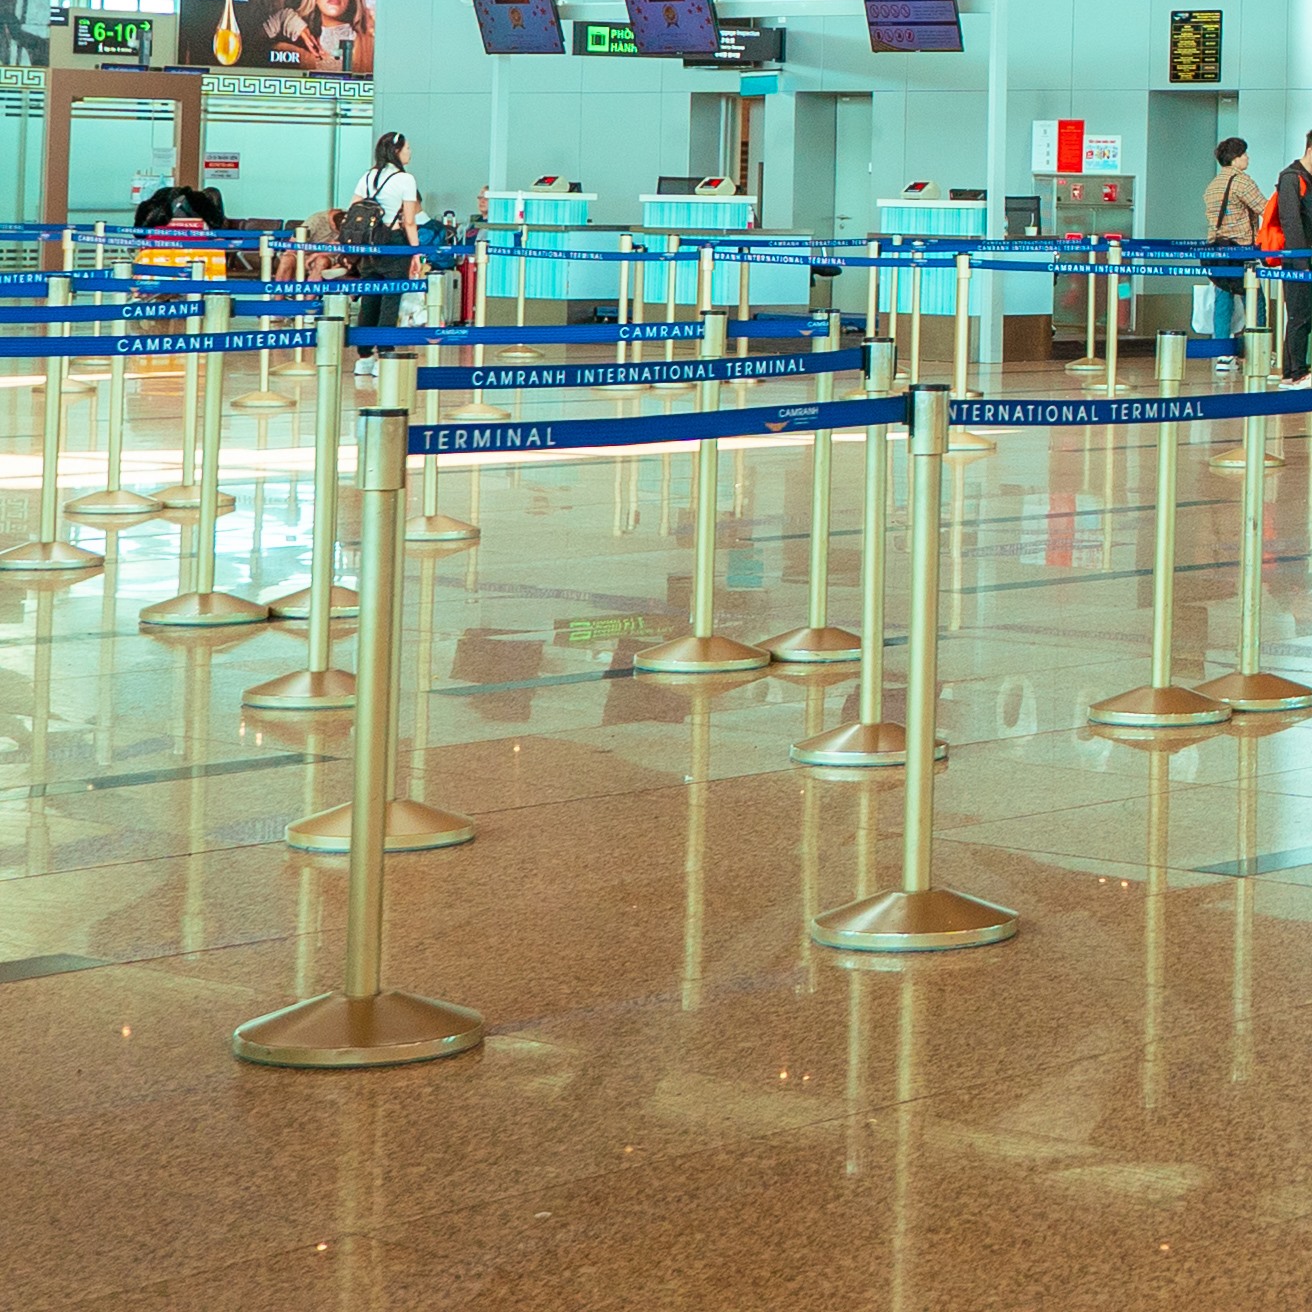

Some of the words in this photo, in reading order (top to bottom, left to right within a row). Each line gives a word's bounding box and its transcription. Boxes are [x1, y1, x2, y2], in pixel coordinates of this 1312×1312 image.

[93, 21, 137, 42] 6-10
[611, 28, 634, 39] PHÒ
[270, 51, 300, 63] DIOR
[78, 235, 106, 243] CAMRANH
[108, 236, 152, 247] INTERNATIONAL
[294, 242, 345, 252] INTERNATIONAL
[348, 245, 381, 253] TERMINAL
[513, 248, 566, 258] INTERNATIONAL
[570, 252, 603, 260] TERMINAL
[744, 253, 803, 264] INTERNATIONAL
[808, 257, 846, 266] TERMINAL
[1147, 251, 1197, 259] INTERNATIONAL
[1047, 264, 1091, 273] CAMRANH
[1094, 265, 1164, 275] INTERNATIONAL
[1168, 266, 1213, 276] TERMINAL
[1259, 269, 1304, 280] CAMRANH
[265, 282, 330, 293] CAMRANH
[122, 303, 199, 317] CAMRANH
[619, 326, 704, 338] CAMRANH
[117, 337, 214, 352] CAMRANH
[225, 332, 313, 348] INTERNAT
[472, 368, 566, 387] CAMRANH
[577, 363, 715, 384] INTERNATIONAL
[726, 356, 806, 377] TERMINAL
[778, 407, 820, 418] CAMRANH
[1111, 401, 1205, 419] TERMINAL
[423, 426, 557, 450] TERMINAL
